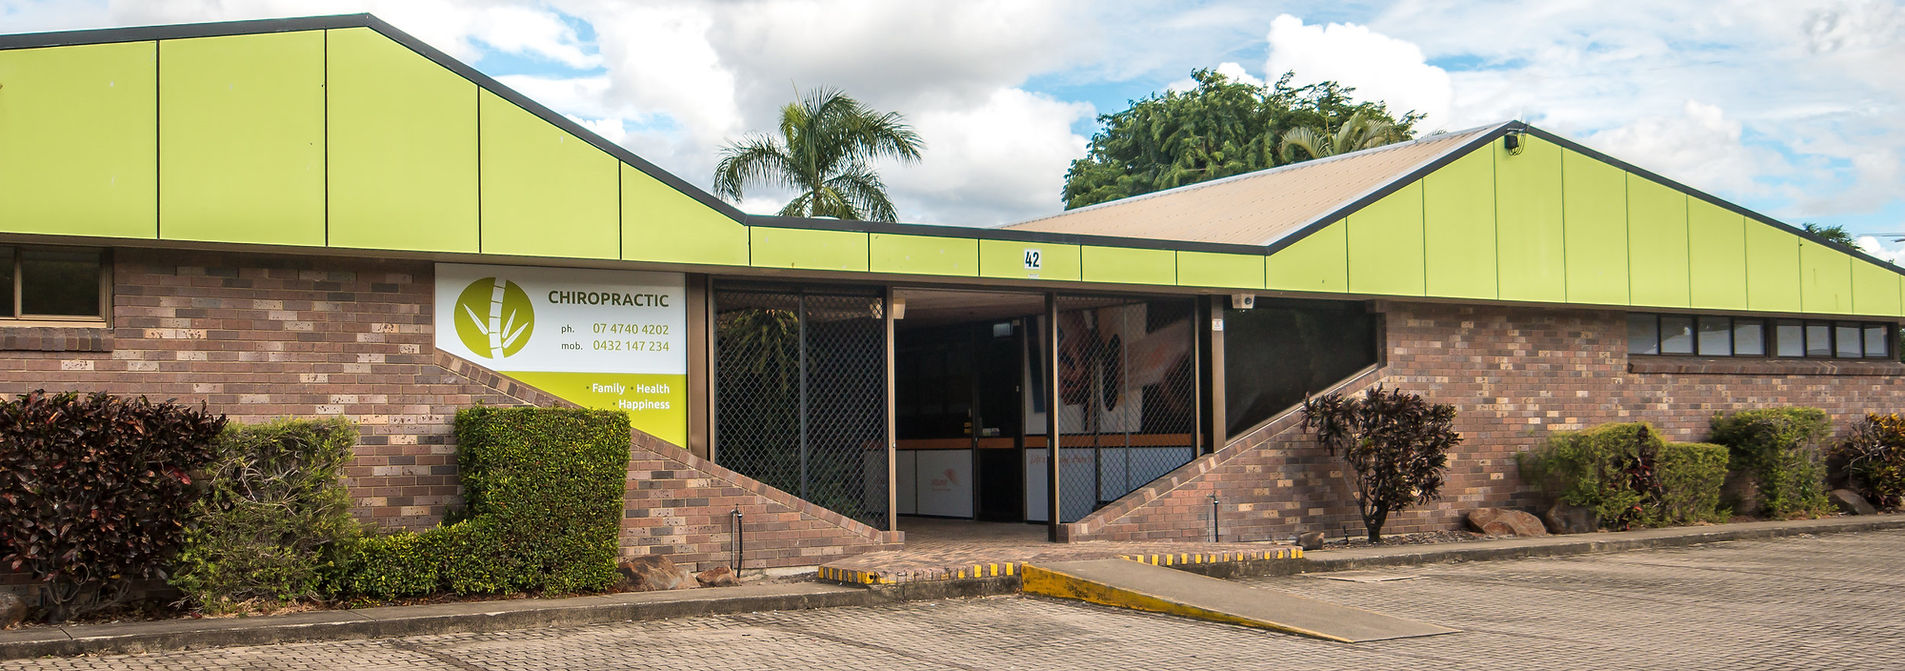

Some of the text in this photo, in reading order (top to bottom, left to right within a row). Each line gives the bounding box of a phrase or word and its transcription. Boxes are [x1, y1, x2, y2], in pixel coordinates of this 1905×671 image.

[1025, 251, 1039, 267] 42
[548, 290, 669, 307] CHIROPRACTIC
[561, 323, 669, 335] ph. 07 4740 4202
[561, 340, 669, 352] mob. 0432 147 234
[592, 383, 670, 395] Family Health
[618, 399, 670, 411] Happiness
